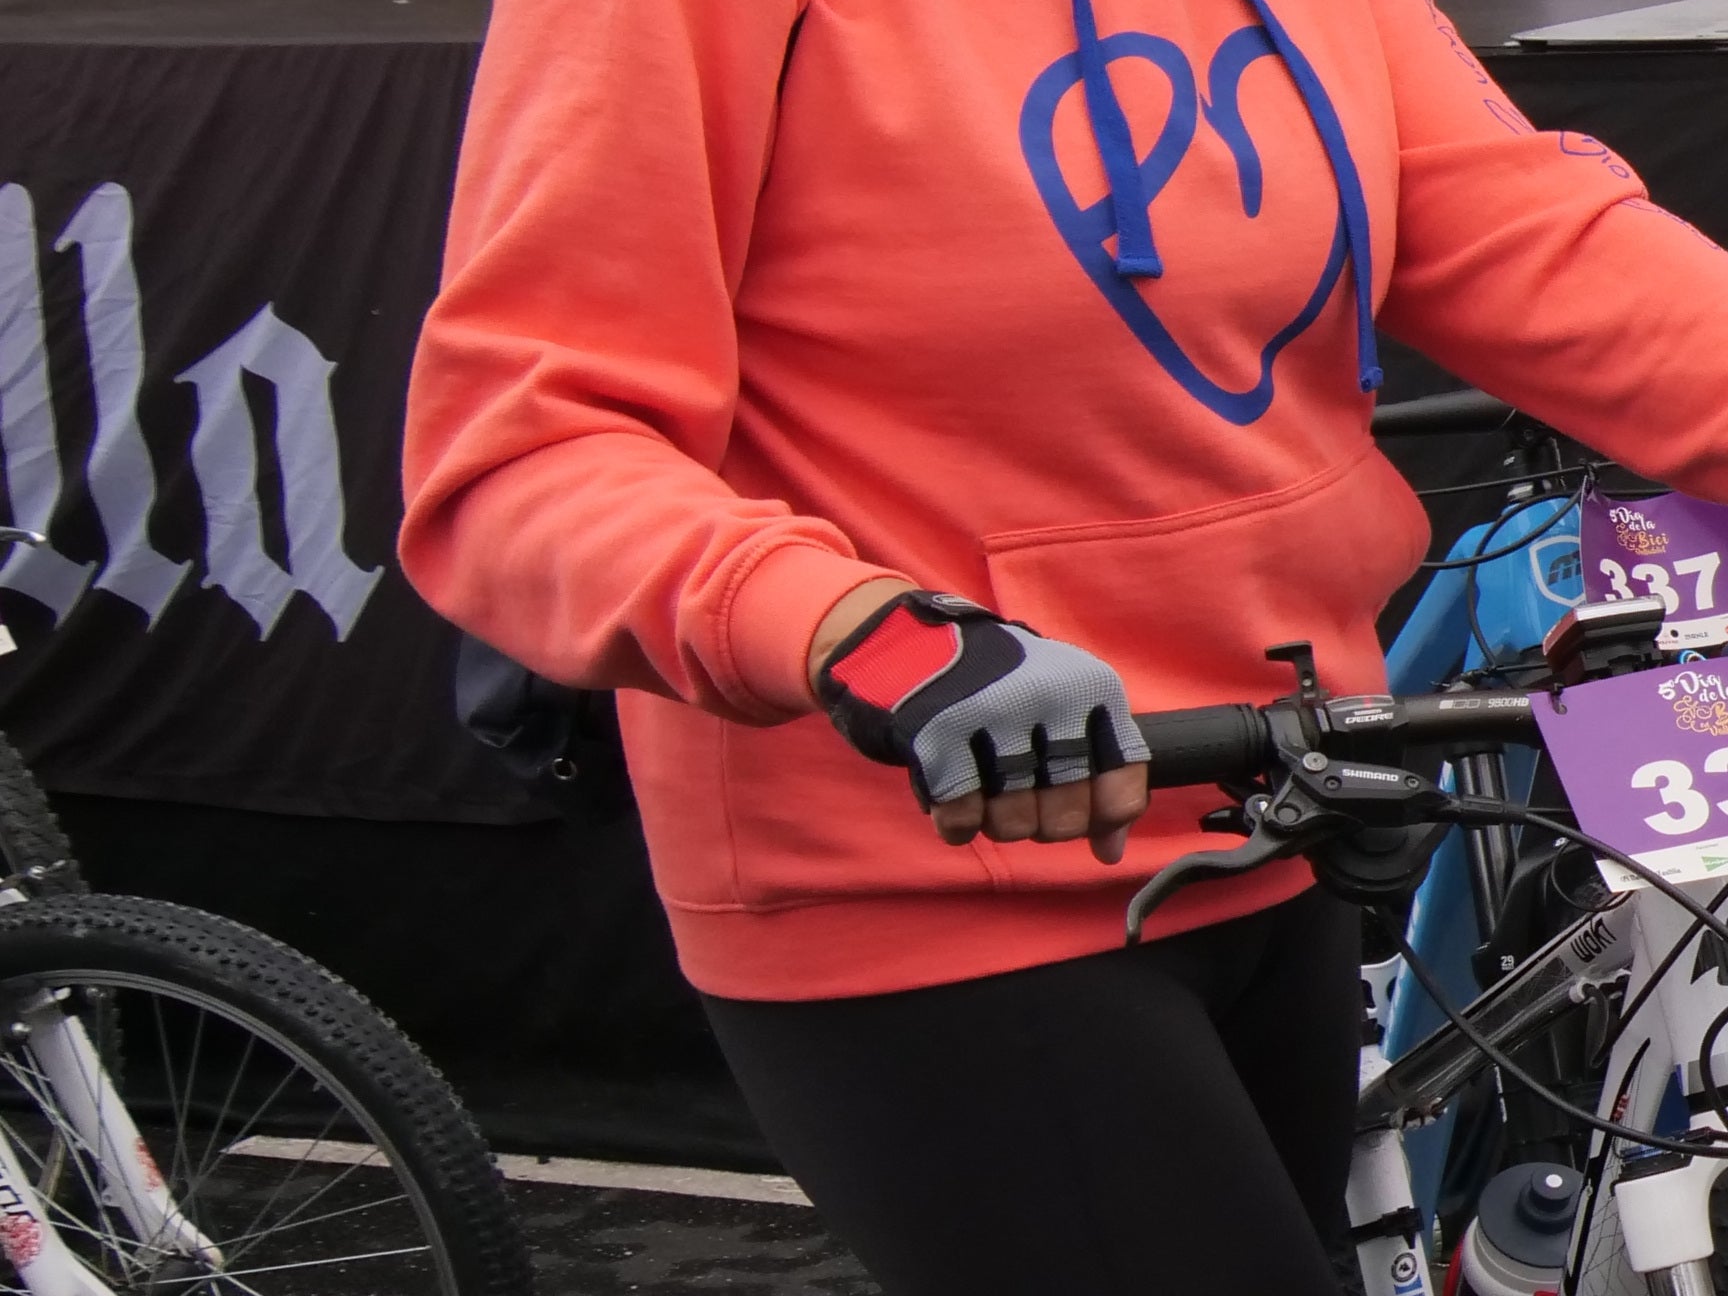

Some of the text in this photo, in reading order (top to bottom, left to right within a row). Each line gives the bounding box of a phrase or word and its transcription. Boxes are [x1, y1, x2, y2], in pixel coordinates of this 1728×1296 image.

[1600, 552, 1721, 616] 337
[1341, 769, 1399, 782] SHIMANO
[1500, 954, 1515, 967] 29
